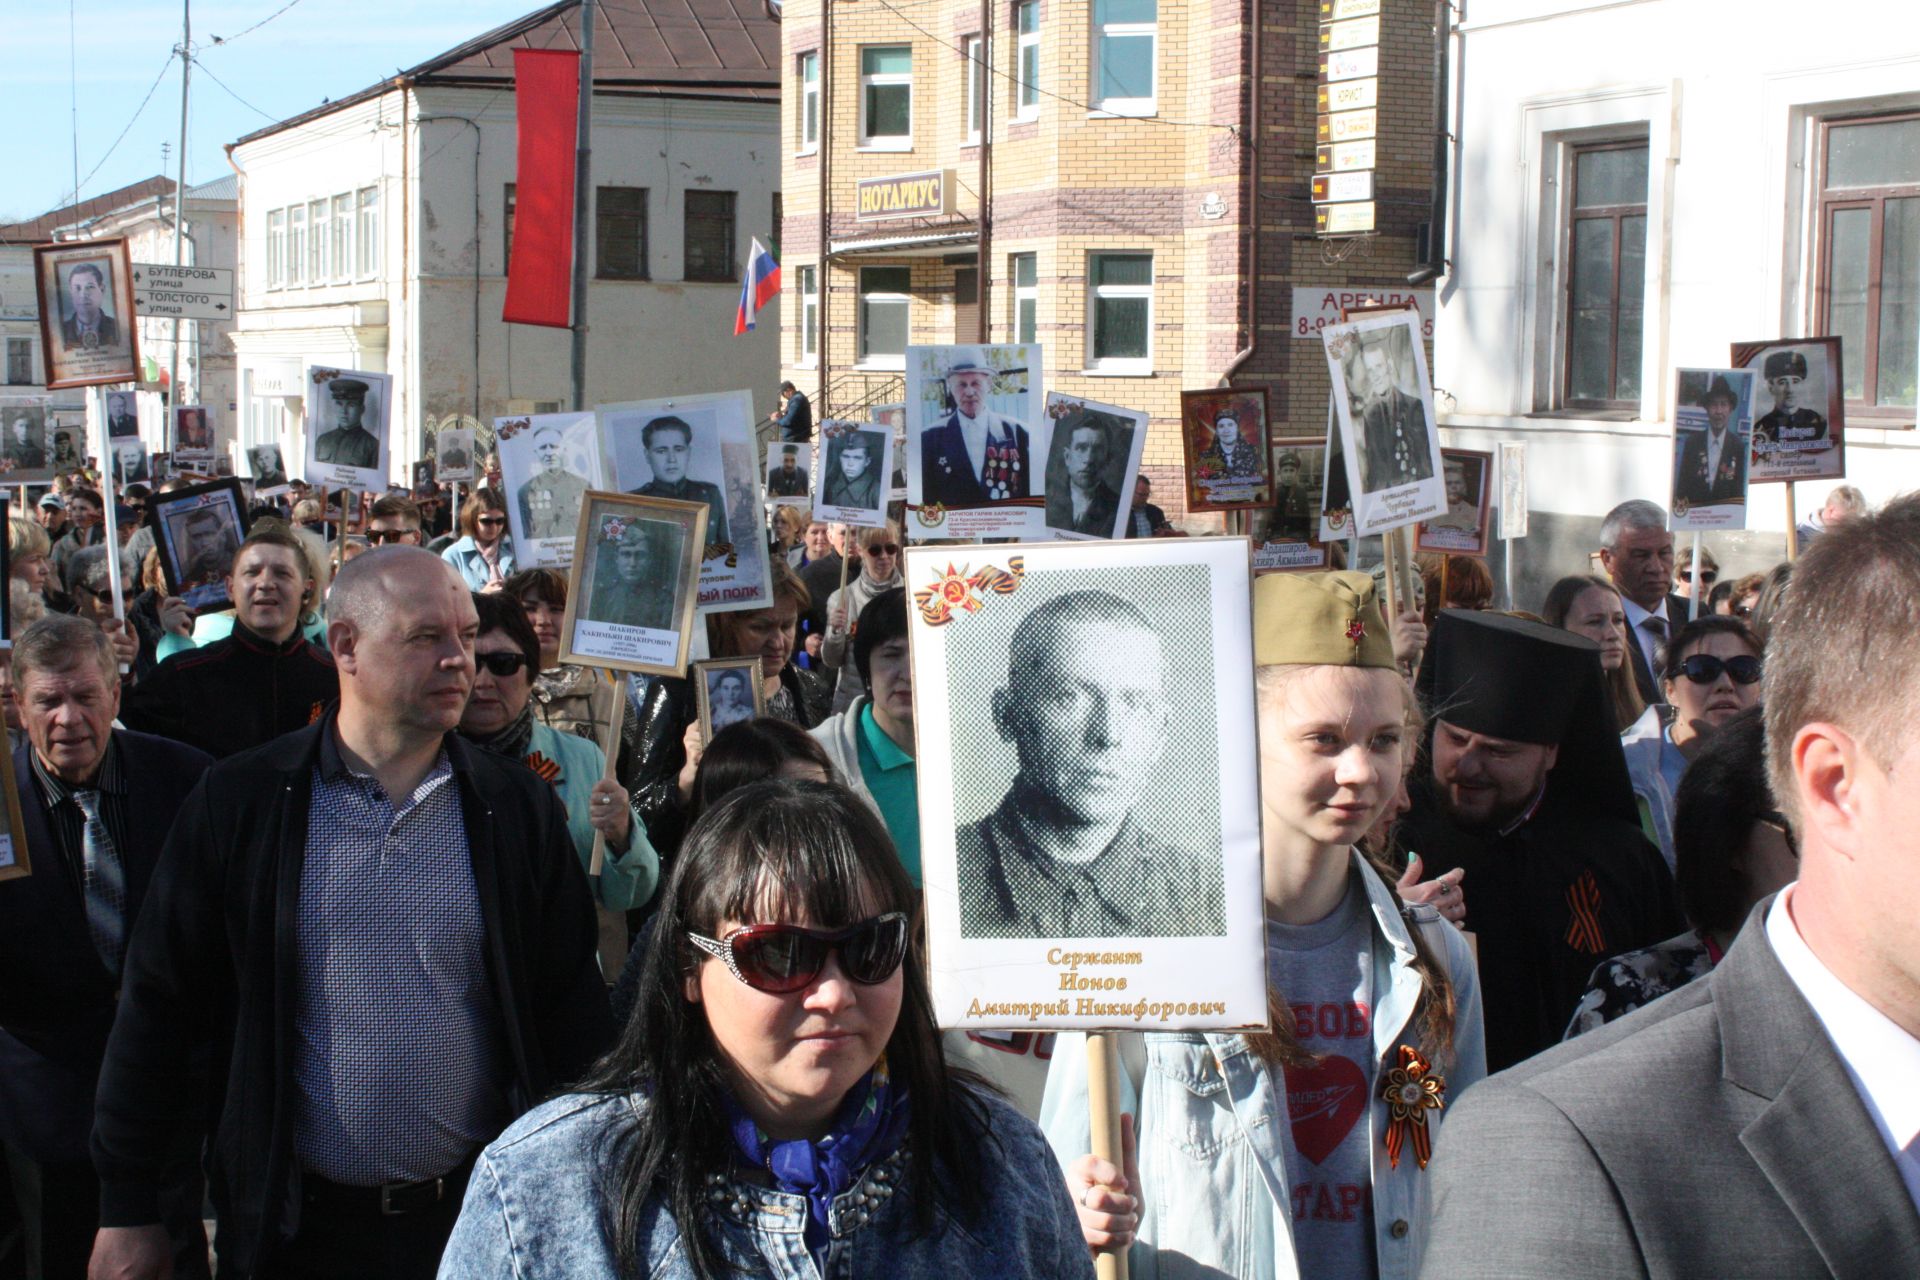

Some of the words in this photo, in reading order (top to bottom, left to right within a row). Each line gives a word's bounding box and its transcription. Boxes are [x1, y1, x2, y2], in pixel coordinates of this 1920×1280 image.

[860, 178, 940, 213] НОТАРИУС
[148, 267, 217, 280] БУТЛЕРОВА
[149, 279, 183, 288] улица
[149, 292, 210, 304] ТОЛСТОГО
[149, 304, 183, 313] улица
[723, 586, 759, 600] ПОЛК
[608, 625, 646, 635] ШАКИРОВ
[624, 634, 672, 647] ШАКИРОВИЧ
[1047, 948, 1143, 970] Сержант
[1058, 972, 1128, 991] Ионов
[967, 998, 1070, 1021] Дмитрий
[1074, 998, 1226, 1022] Никифорович
